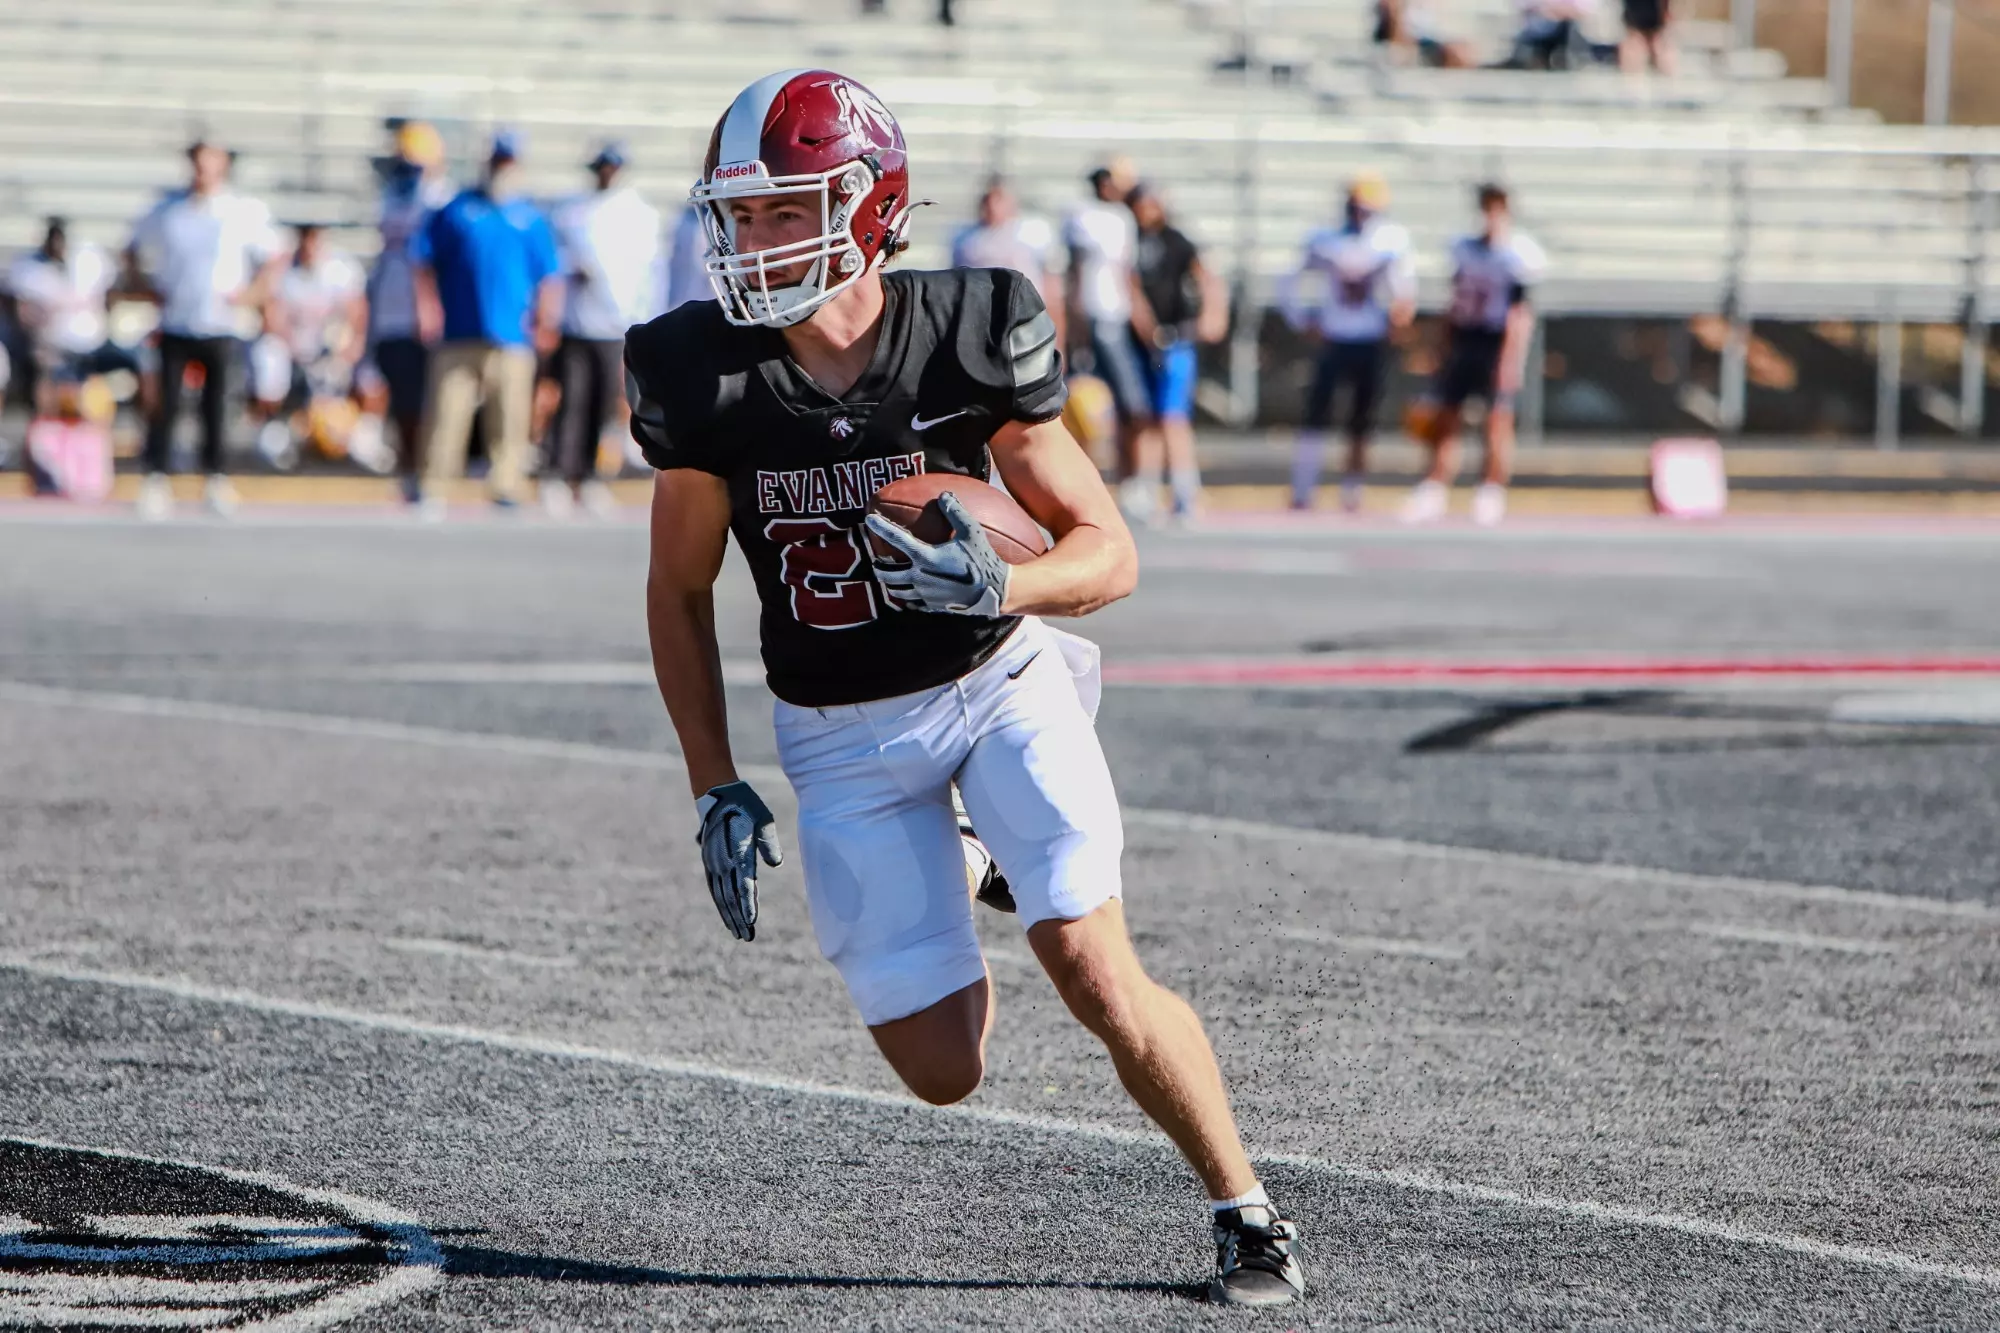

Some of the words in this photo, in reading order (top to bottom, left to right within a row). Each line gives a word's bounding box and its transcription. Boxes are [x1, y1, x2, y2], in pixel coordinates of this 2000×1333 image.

[715, 163, 757, 179] Riddell
[716, 225, 735, 256] Riddel
[764, 518, 906, 630] 2
